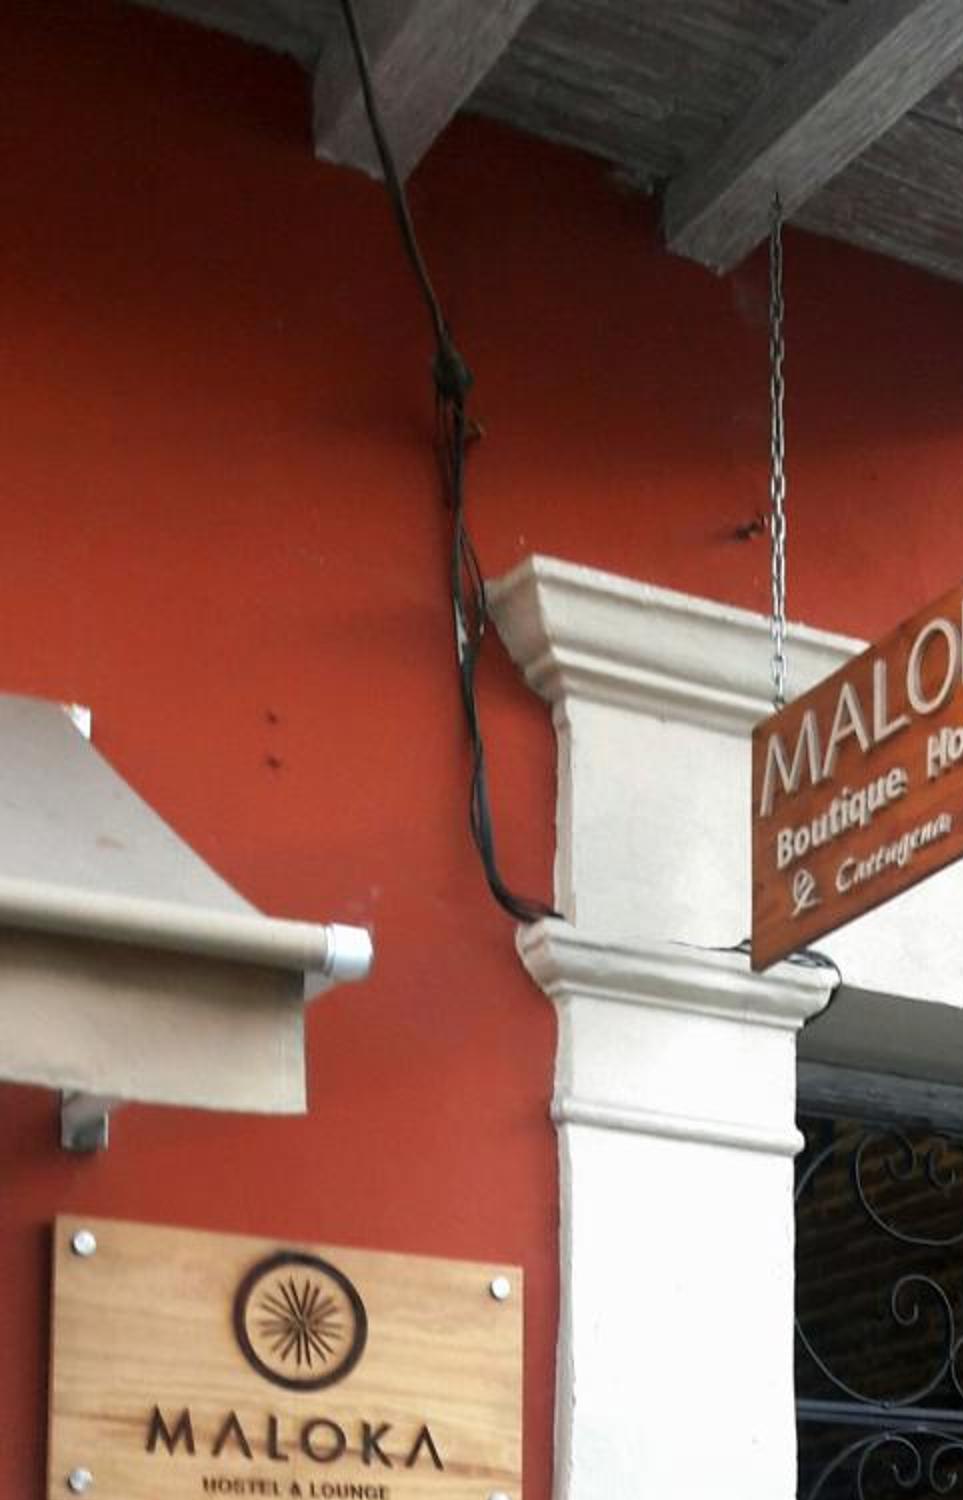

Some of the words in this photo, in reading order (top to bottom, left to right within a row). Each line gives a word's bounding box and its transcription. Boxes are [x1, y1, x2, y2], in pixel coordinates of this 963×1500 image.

[776, 768, 907, 869] Boutique
[835, 812, 953, 893] Cartagena
[145, 1404, 446, 1471] MALOKA
[202, 1475, 281, 1498] HOSTEL
